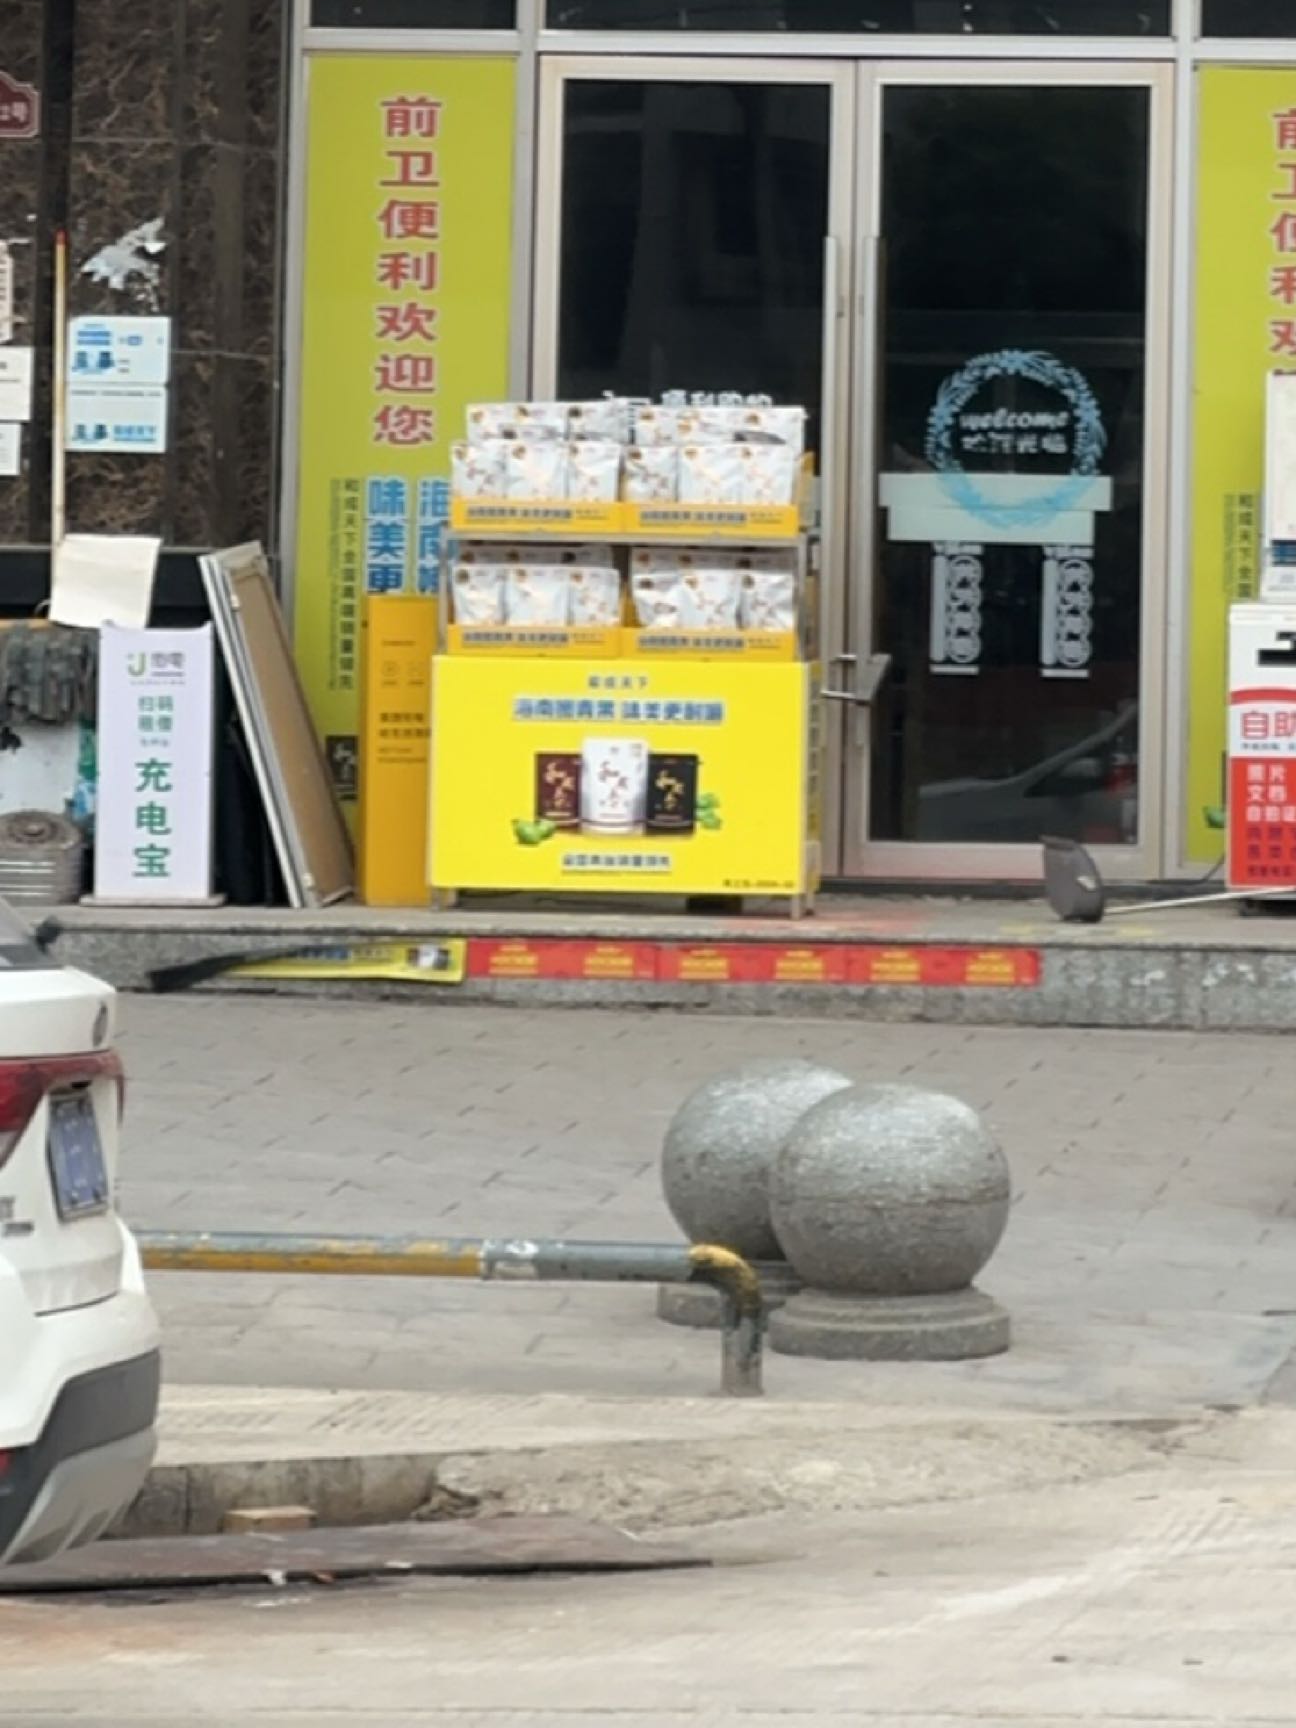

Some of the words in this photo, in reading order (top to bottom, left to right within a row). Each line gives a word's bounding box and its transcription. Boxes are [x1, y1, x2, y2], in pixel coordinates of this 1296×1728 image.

[374, 97, 442, 446] 前卫便利欢迎您
[132, 758, 173, 878] 充电宝
